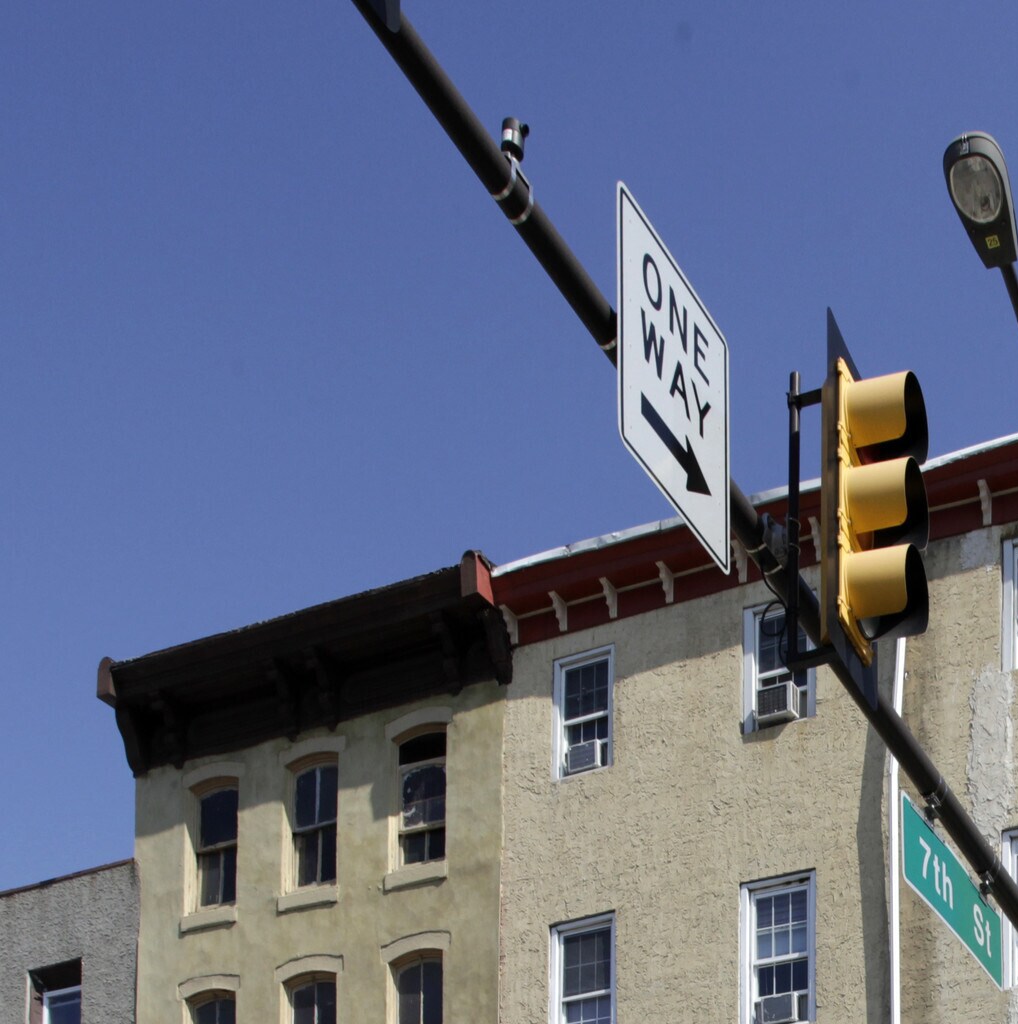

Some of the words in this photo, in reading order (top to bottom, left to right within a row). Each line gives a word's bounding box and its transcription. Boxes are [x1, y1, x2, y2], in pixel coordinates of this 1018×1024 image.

[640, 306, 711, 439] WAY
[643, 253, 710, 387] ONE
[919, 836, 953, 910] 7th
[973, 903, 992, 958] St
